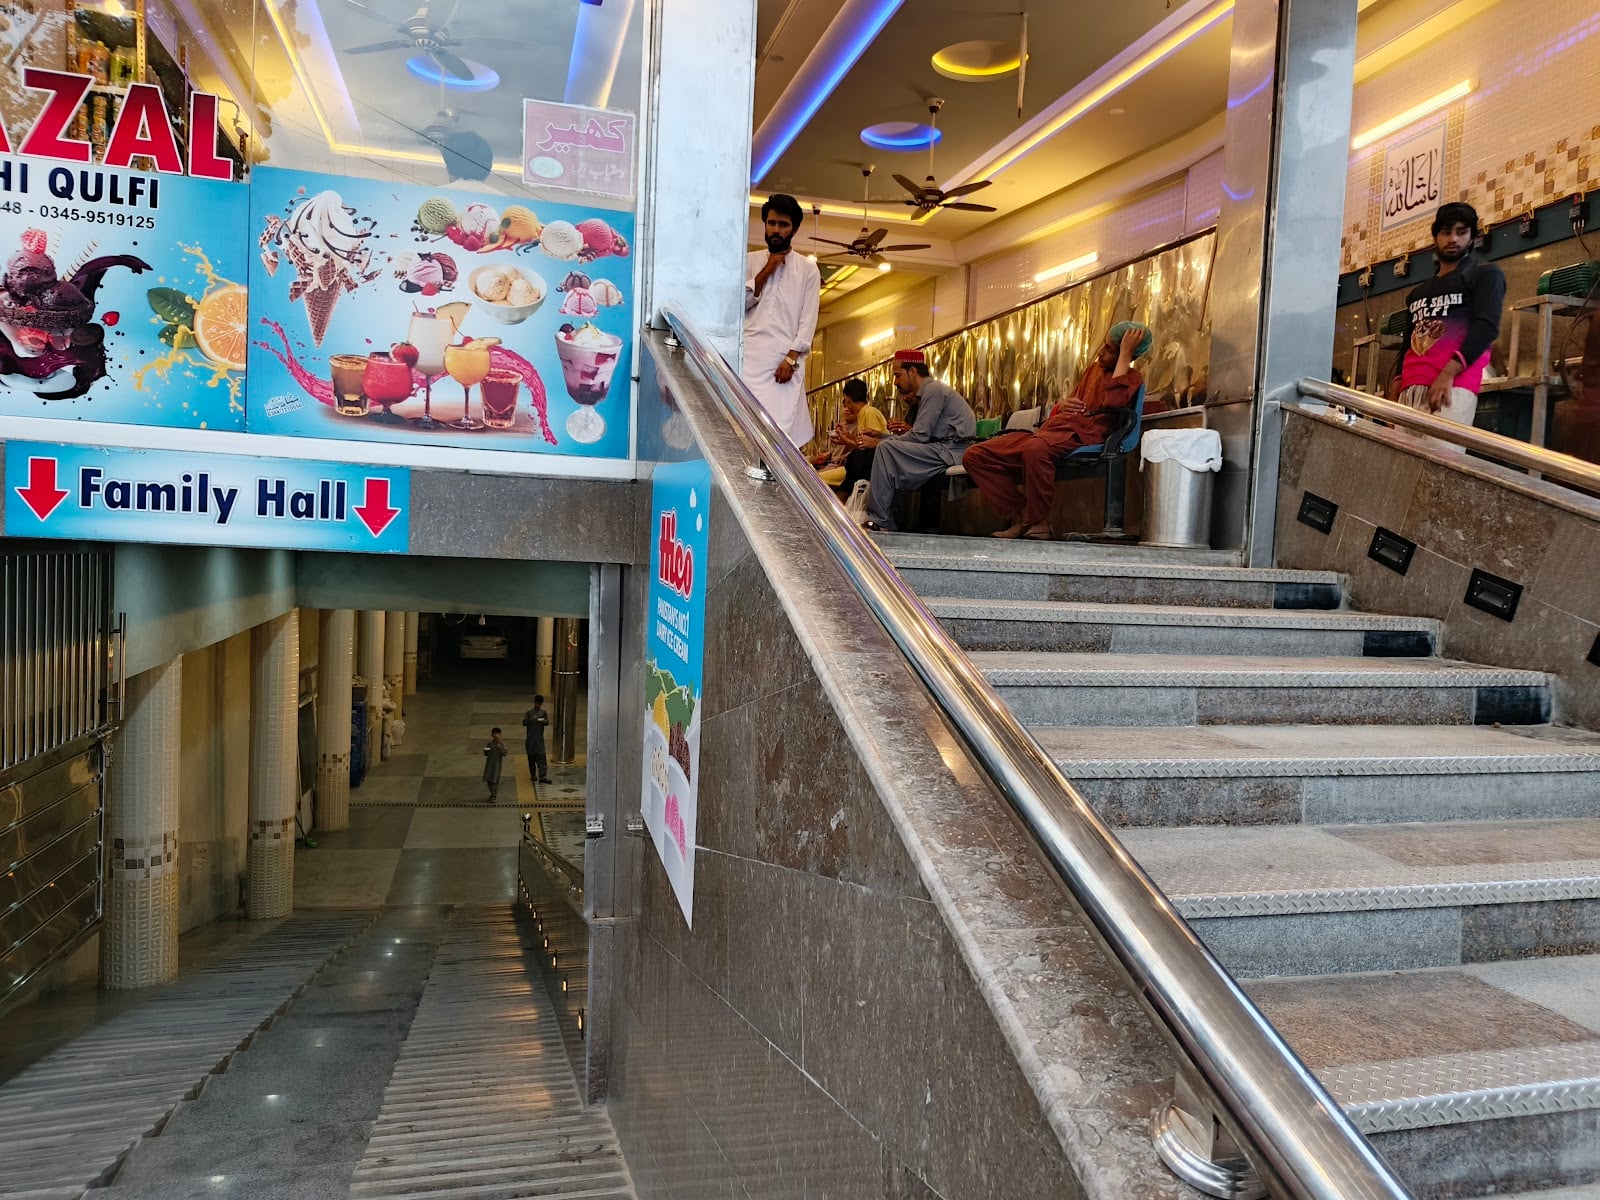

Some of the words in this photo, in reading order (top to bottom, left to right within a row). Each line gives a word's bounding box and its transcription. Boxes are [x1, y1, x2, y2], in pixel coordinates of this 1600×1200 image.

[0, 67, 233, 181] ZAL
[48, 167, 159, 209] QULFI
[40, 205, 155, 229] 0345-9519125
[1429, 293, 1463, 308] SHAHI
[79, 467, 239, 525] Family
[256, 478, 347, 521] Hall
